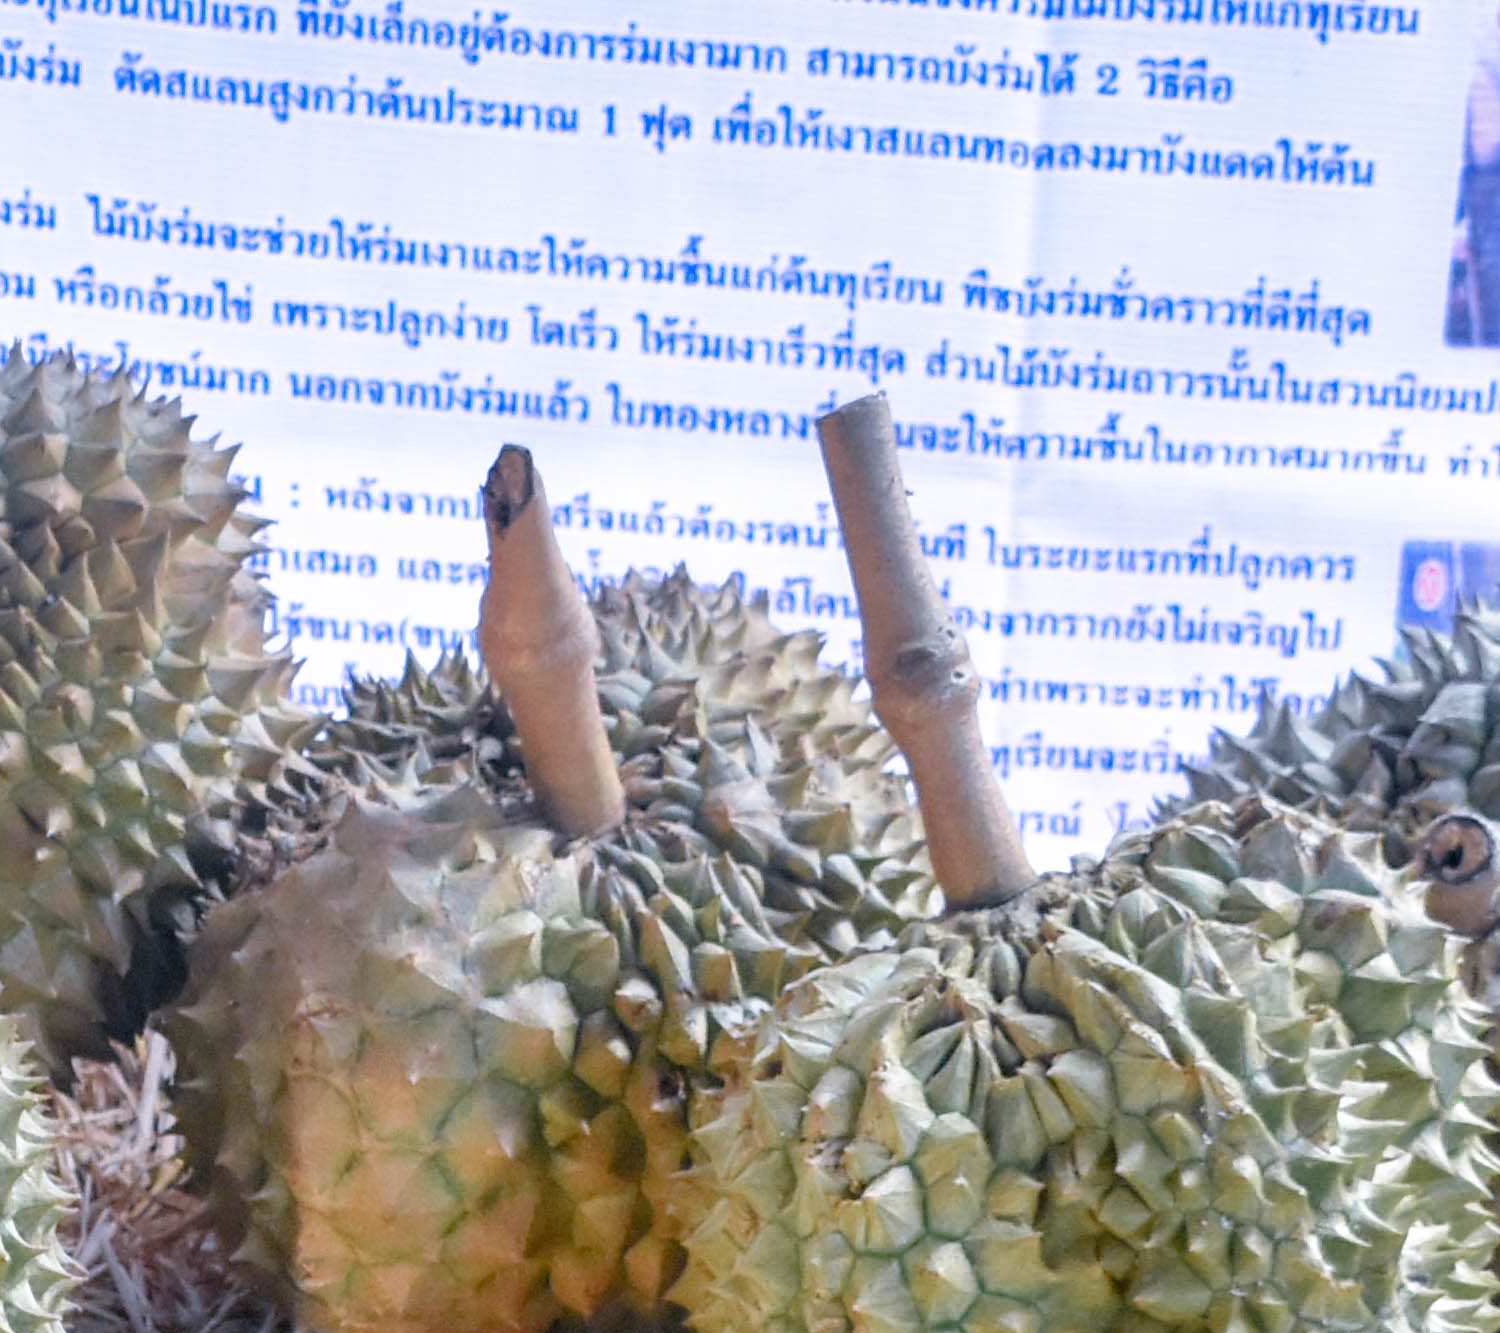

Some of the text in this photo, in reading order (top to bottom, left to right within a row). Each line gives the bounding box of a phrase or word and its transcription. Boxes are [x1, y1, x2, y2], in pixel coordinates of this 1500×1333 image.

[1098, 62, 1120, 96] 2
[1138, 56, 1235, 104] วิธีคือ
[602, 104, 617, 138] 1
[54, 264, 252, 324] หรือกล้วยไข่
[271, 298, 510, 348] เพราะปลูกง่าย
[525, 304, 620, 353] โตเร็ว
[289, 369, 591, 424] นอกจากบังร่มแล้ว
